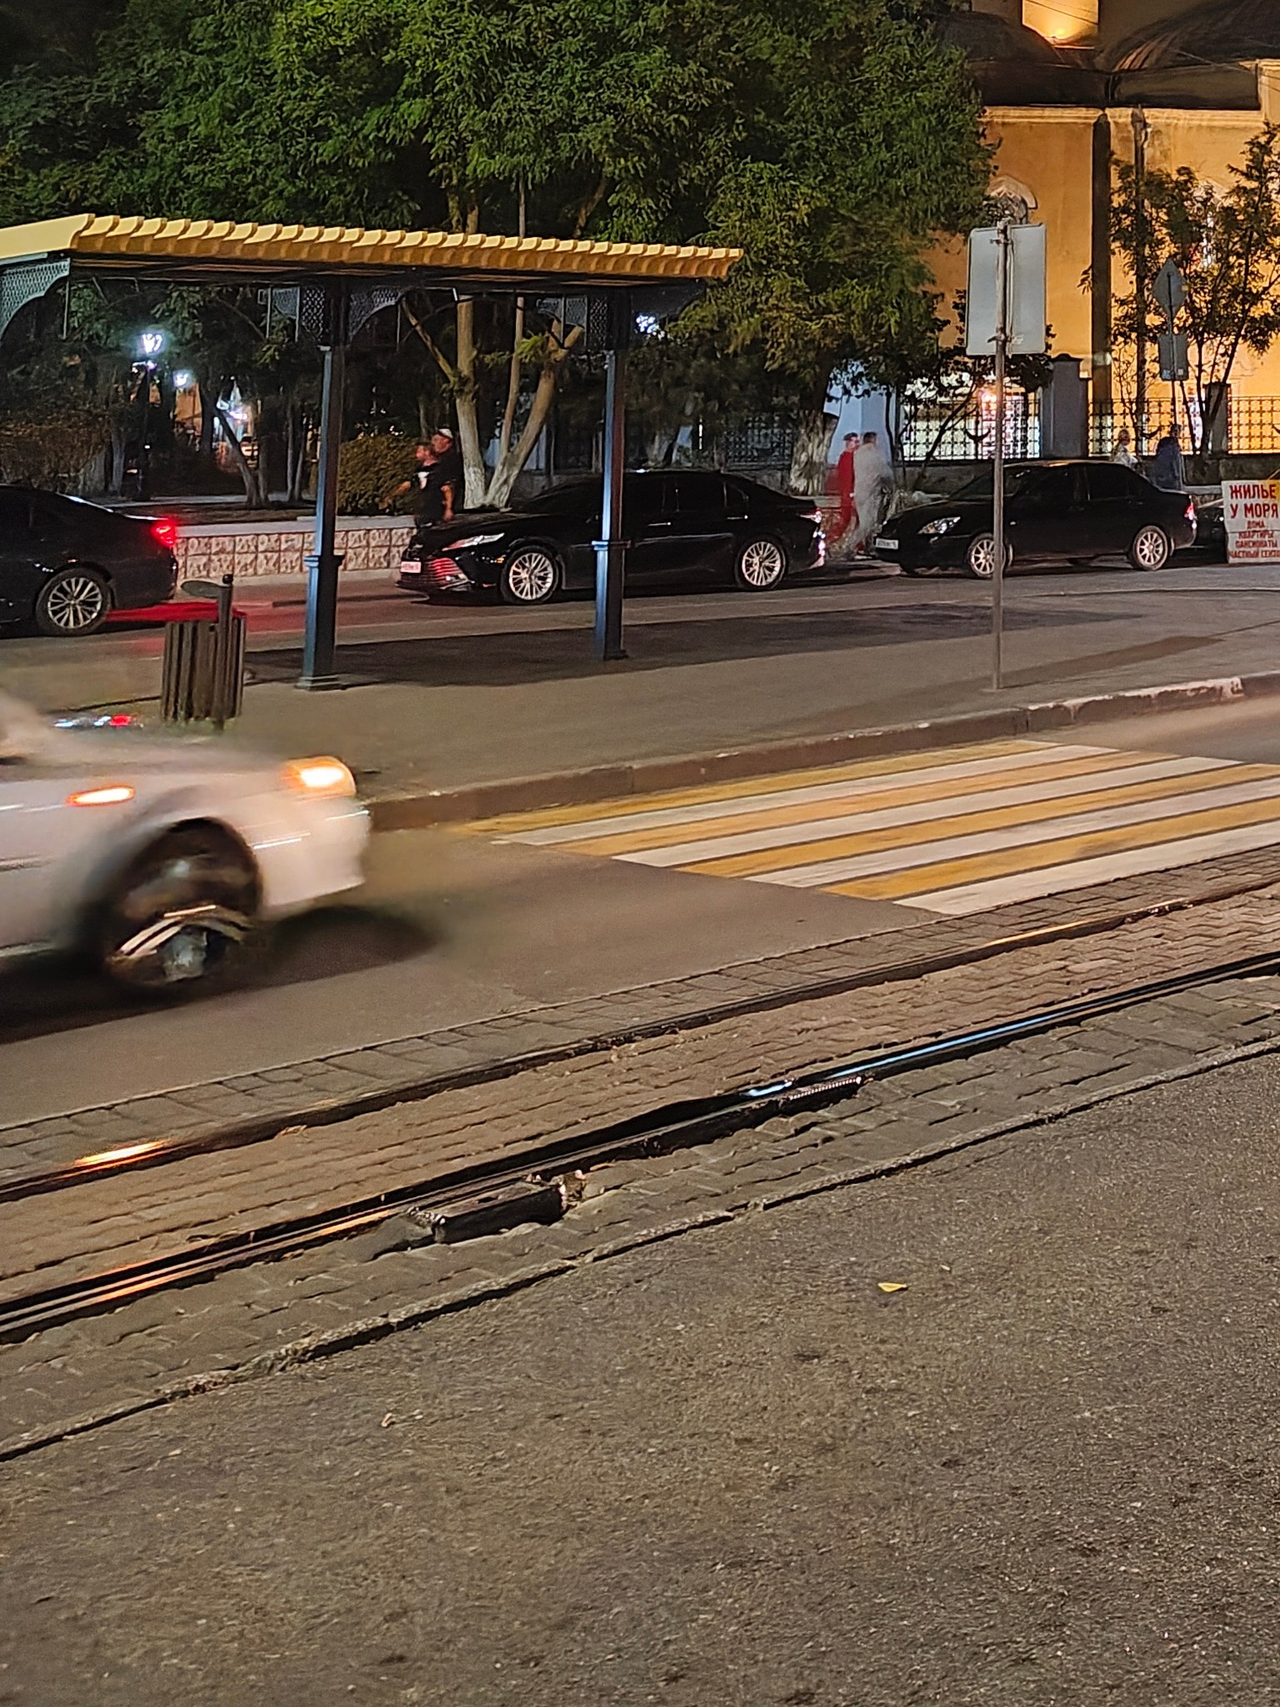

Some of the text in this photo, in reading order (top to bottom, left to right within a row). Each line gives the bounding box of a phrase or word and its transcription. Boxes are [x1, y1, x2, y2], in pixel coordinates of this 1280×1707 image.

[1229, 484, 1277, 499] ЖИЛЬЕ
[1230, 503, 1278, 519] У МОРЯ
[1247, 520, 1265, 529] ДОМА
[1238, 530, 1274, 539] КВАРТИРЫ
